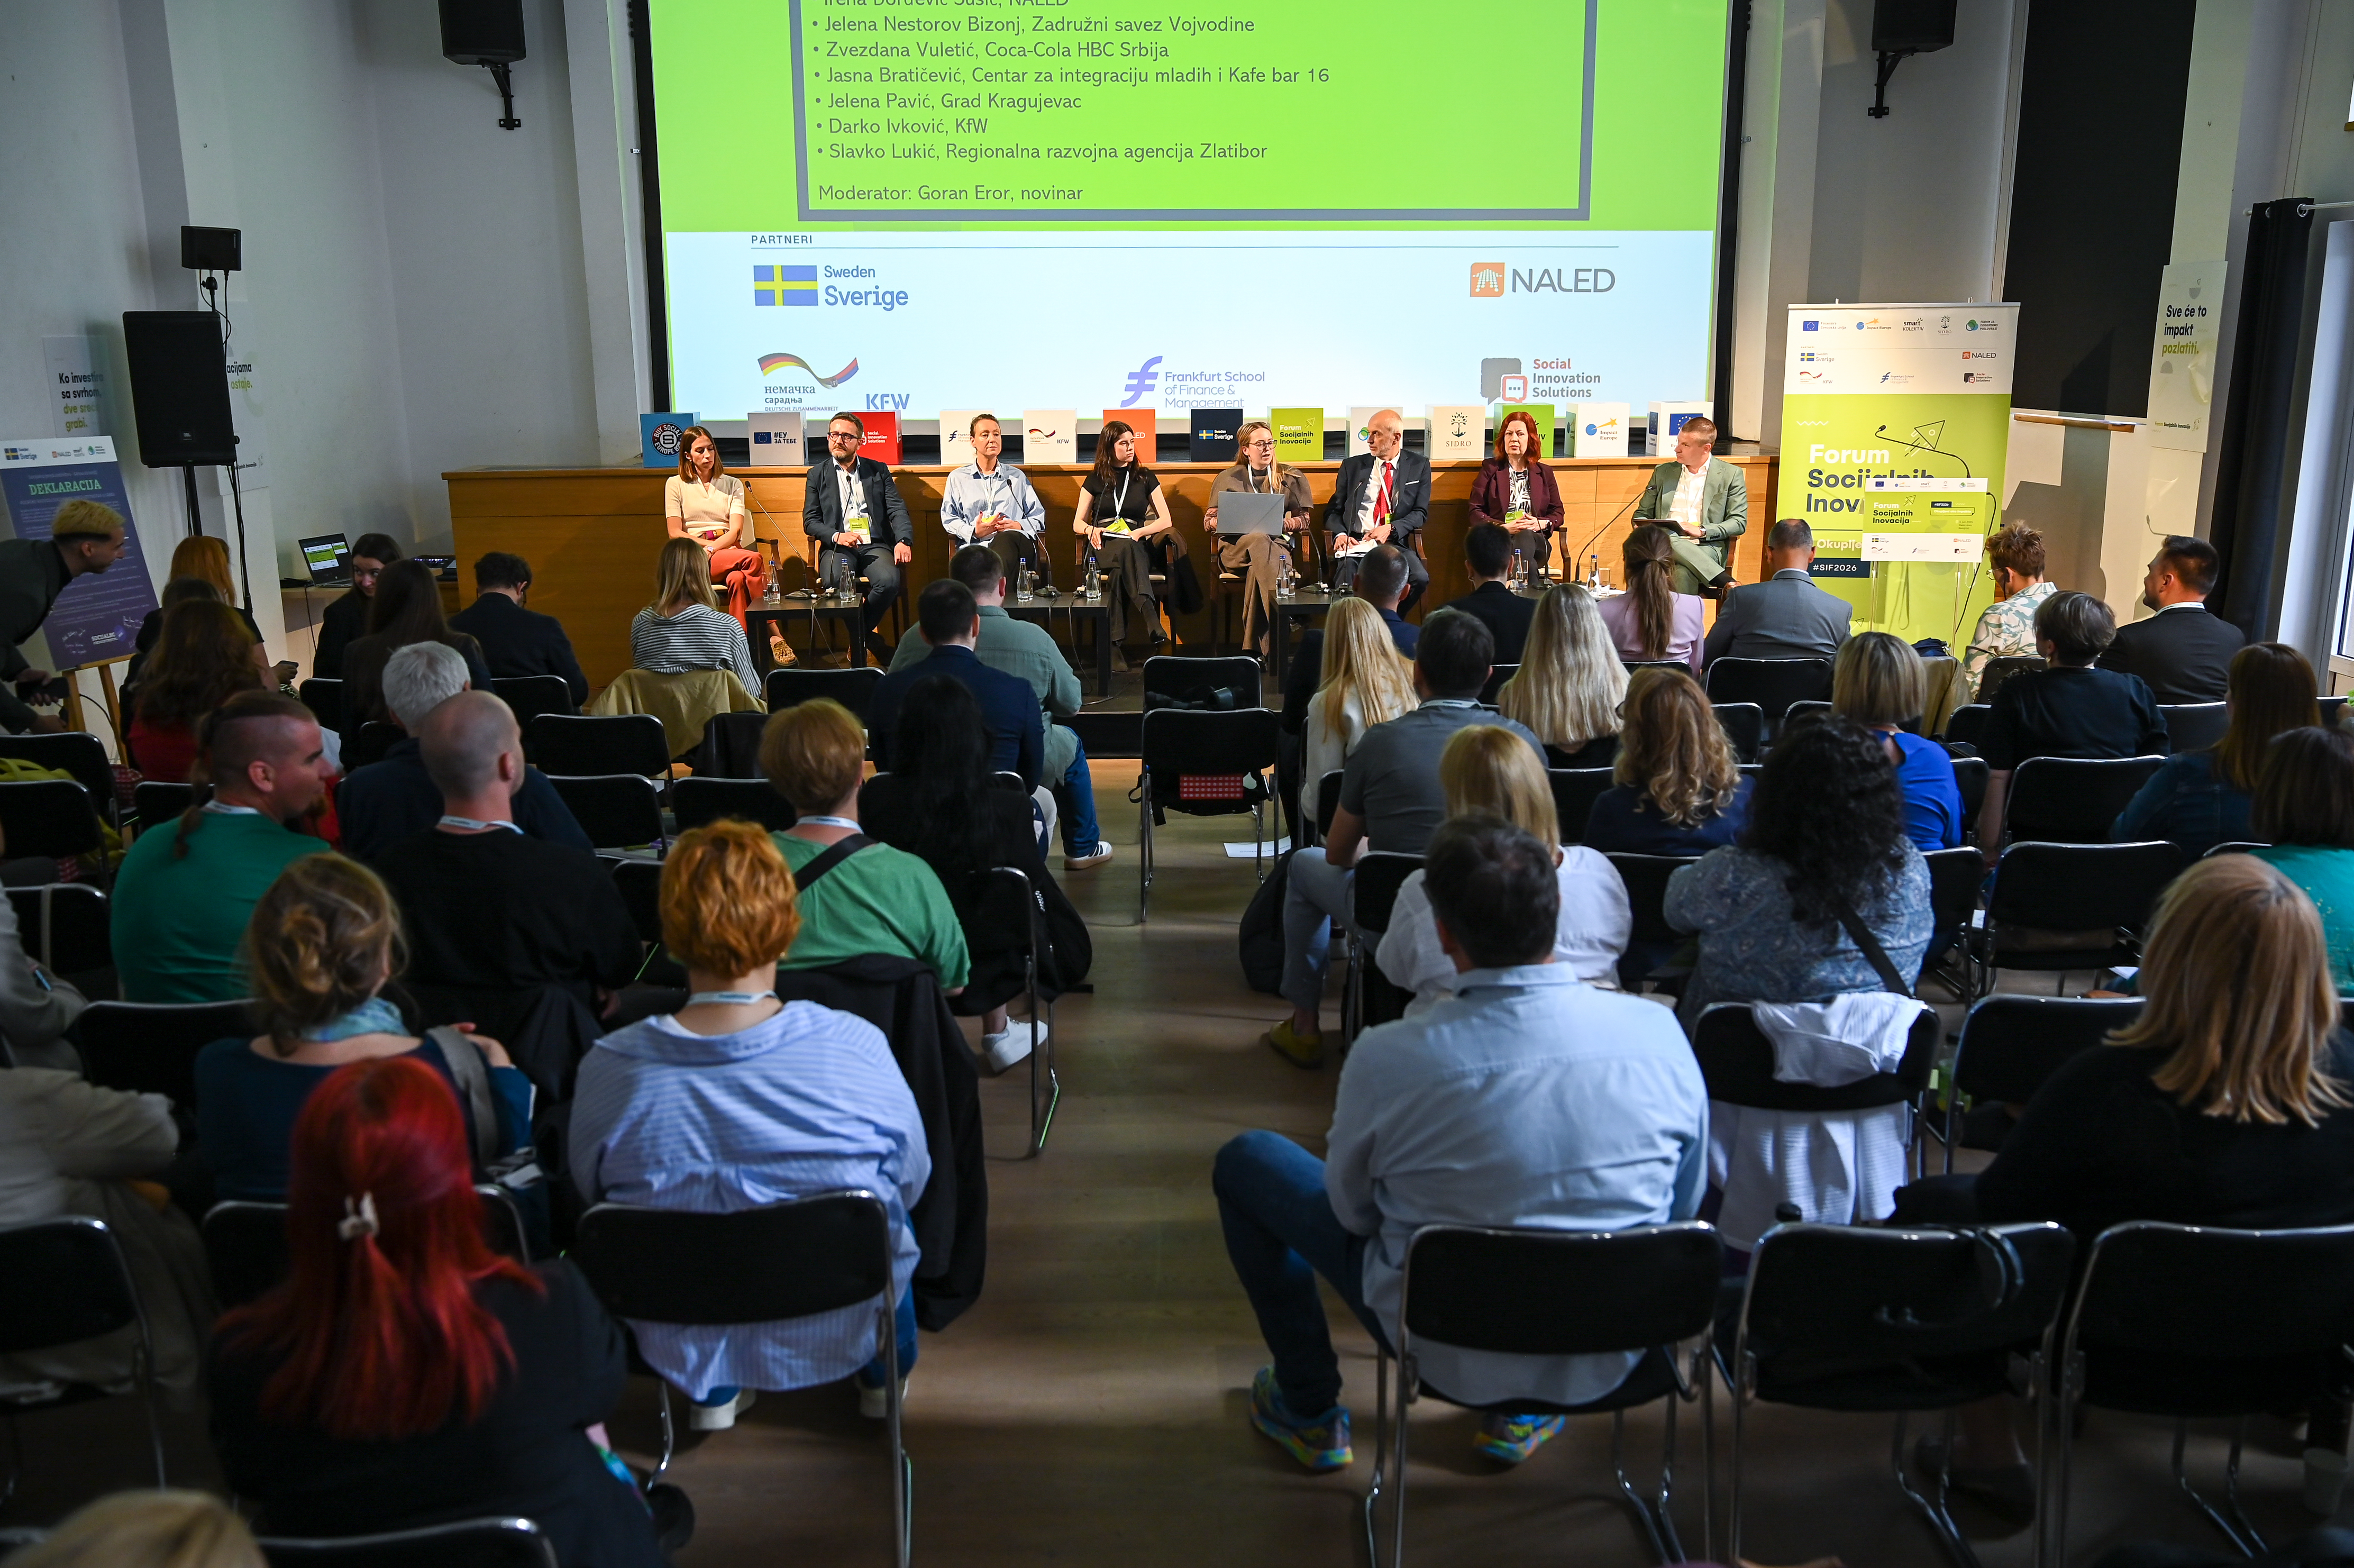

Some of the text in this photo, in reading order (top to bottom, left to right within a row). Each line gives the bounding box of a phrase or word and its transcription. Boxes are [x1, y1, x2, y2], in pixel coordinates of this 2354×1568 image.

[825, 16, 1255, 36] Jelena Nestorov Bizonj, Zadružni savez Vojvodine
[826, 41, 1170, 62] Zvezdana Vuletić, Coca-Cola HBC Srbija
[827, 66, 1330, 87] Jasna Bratičević, Centar za integraciju mladih i Kafe bar 16
[828, 93, 1082, 113] Jelena Pavić, Grad Kragujevac
[829, 117, 989, 136] Darko Ivković, KfW
[829, 143, 1268, 163] Slavko Lukić, Regionalna razvojna agencija Zlatibor
[819, 185, 1084, 203] Moderator: Goran Eror, novinar
[751, 235, 813, 244] PARTNERI
[824, 265, 875, 278] Sweden
[1512, 268, 1616, 293] NALED
[824, 285, 909, 311] Sverige
[2166, 305, 2207, 317] Sve će to
[2164, 323, 2194, 339] impakt
[2161, 341, 2199, 357] pozlatiti.
[1533, 358, 1571, 369] Social
[59, 371, 104, 384] Ko investira
[1165, 371, 1265, 381] Frankfurt School
[1533, 372, 1601, 384] Innovation
[231, 378, 253, 391] ostaje.
[764, 385, 816, 394] немачка
[1165, 385, 1235, 395] of Finance &
[61, 387, 102, 399] sa svrhom,
[1532, 387, 1592, 397] Solutions
[63, 403, 78, 414] dve
[1165, 398, 1245, 408] Management
[66, 417, 88, 432] grabi.
[663, 424, 682, 437] SOCIAL
[653, 426, 663, 438] BUY
[654, 442, 675, 454] EUROPE
[1809, 444, 1890, 464] Forum
[29, 479, 102, 495] DEKLARACIJA
